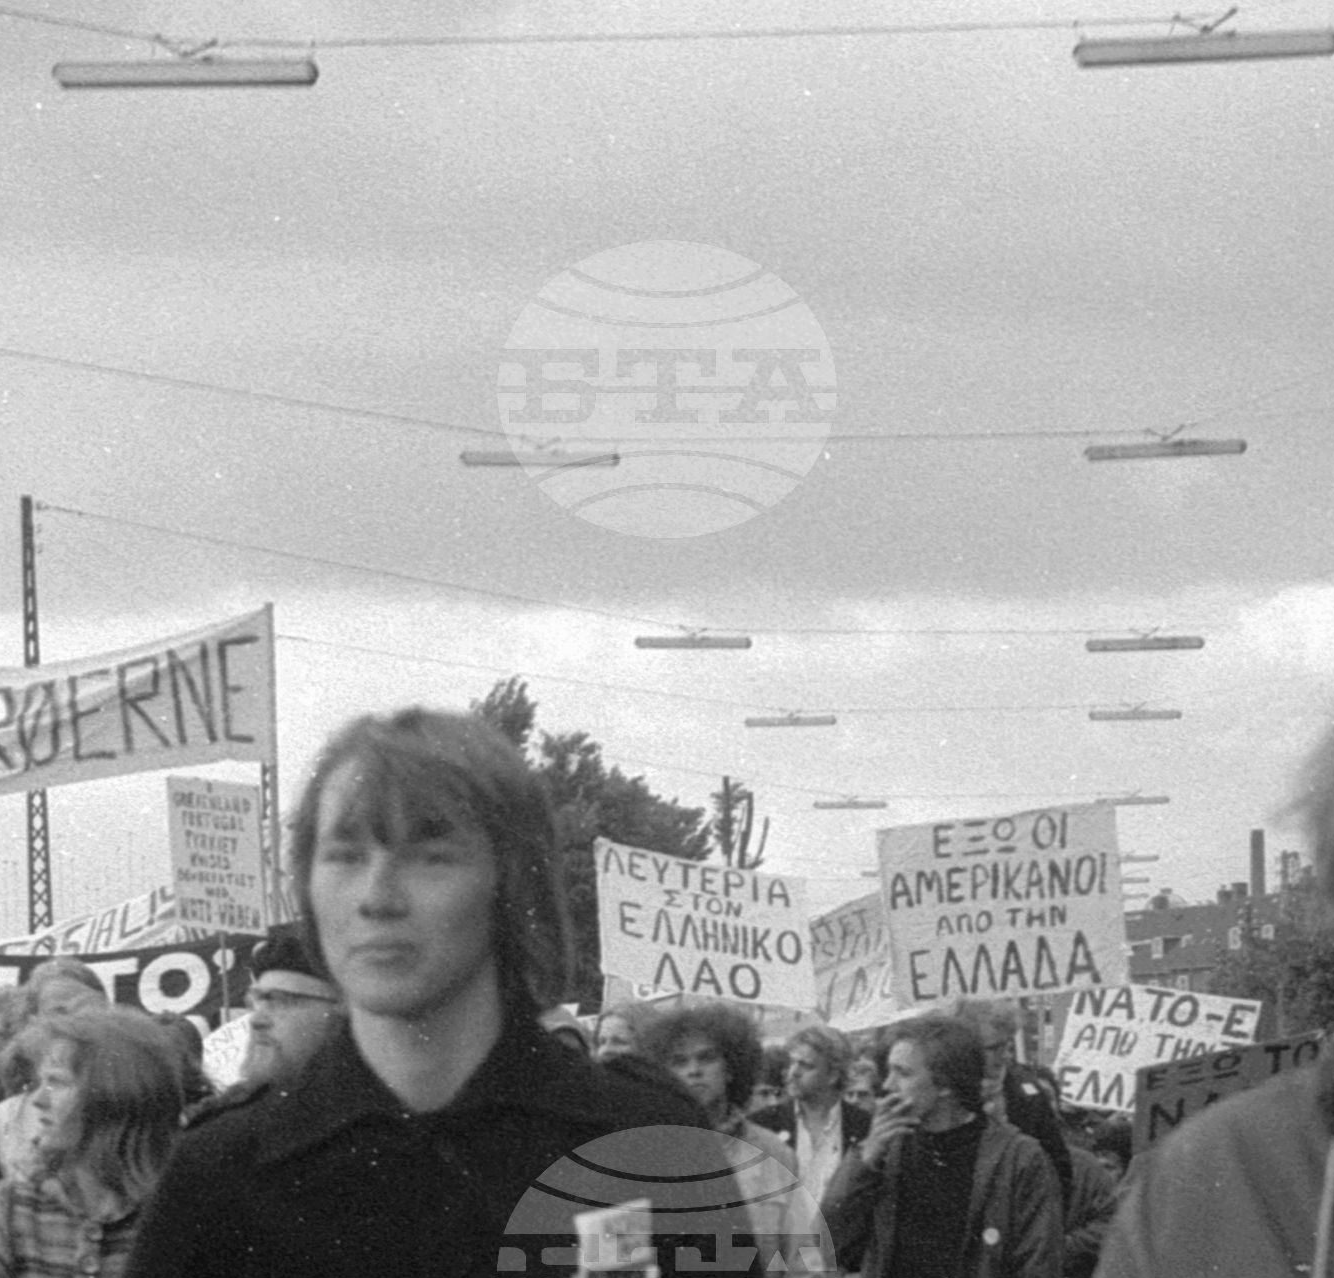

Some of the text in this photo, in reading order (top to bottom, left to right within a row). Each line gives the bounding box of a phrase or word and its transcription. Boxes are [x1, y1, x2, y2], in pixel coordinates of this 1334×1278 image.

[181, 810, 245, 833] PORTUGAL
[932, 811, 1068, 859] ΕΞΩ ΟΙ
[603, 847, 792, 908] ΛΕΥΤΕΡΙΑ
[890, 852, 1107, 910] ΑΜΕΡΙΚΑΝΟΙ
[662, 888, 744, 918] ΣΤΟΝ
[935, 904, 1068, 937] ΑΠΟ ΤΗΝ
[619, 901, 804, 965] ΕΛΛΗΝΙΚΟ
[653, 952, 762, 999] ΛΑΟ
[910, 929, 1102, 1001] ΕΛΛΑΔΑ
[1058, 1066, 1135, 1109] ΕΛΛ
[1146, 1053, 1242, 1090] ΕΞΩ
